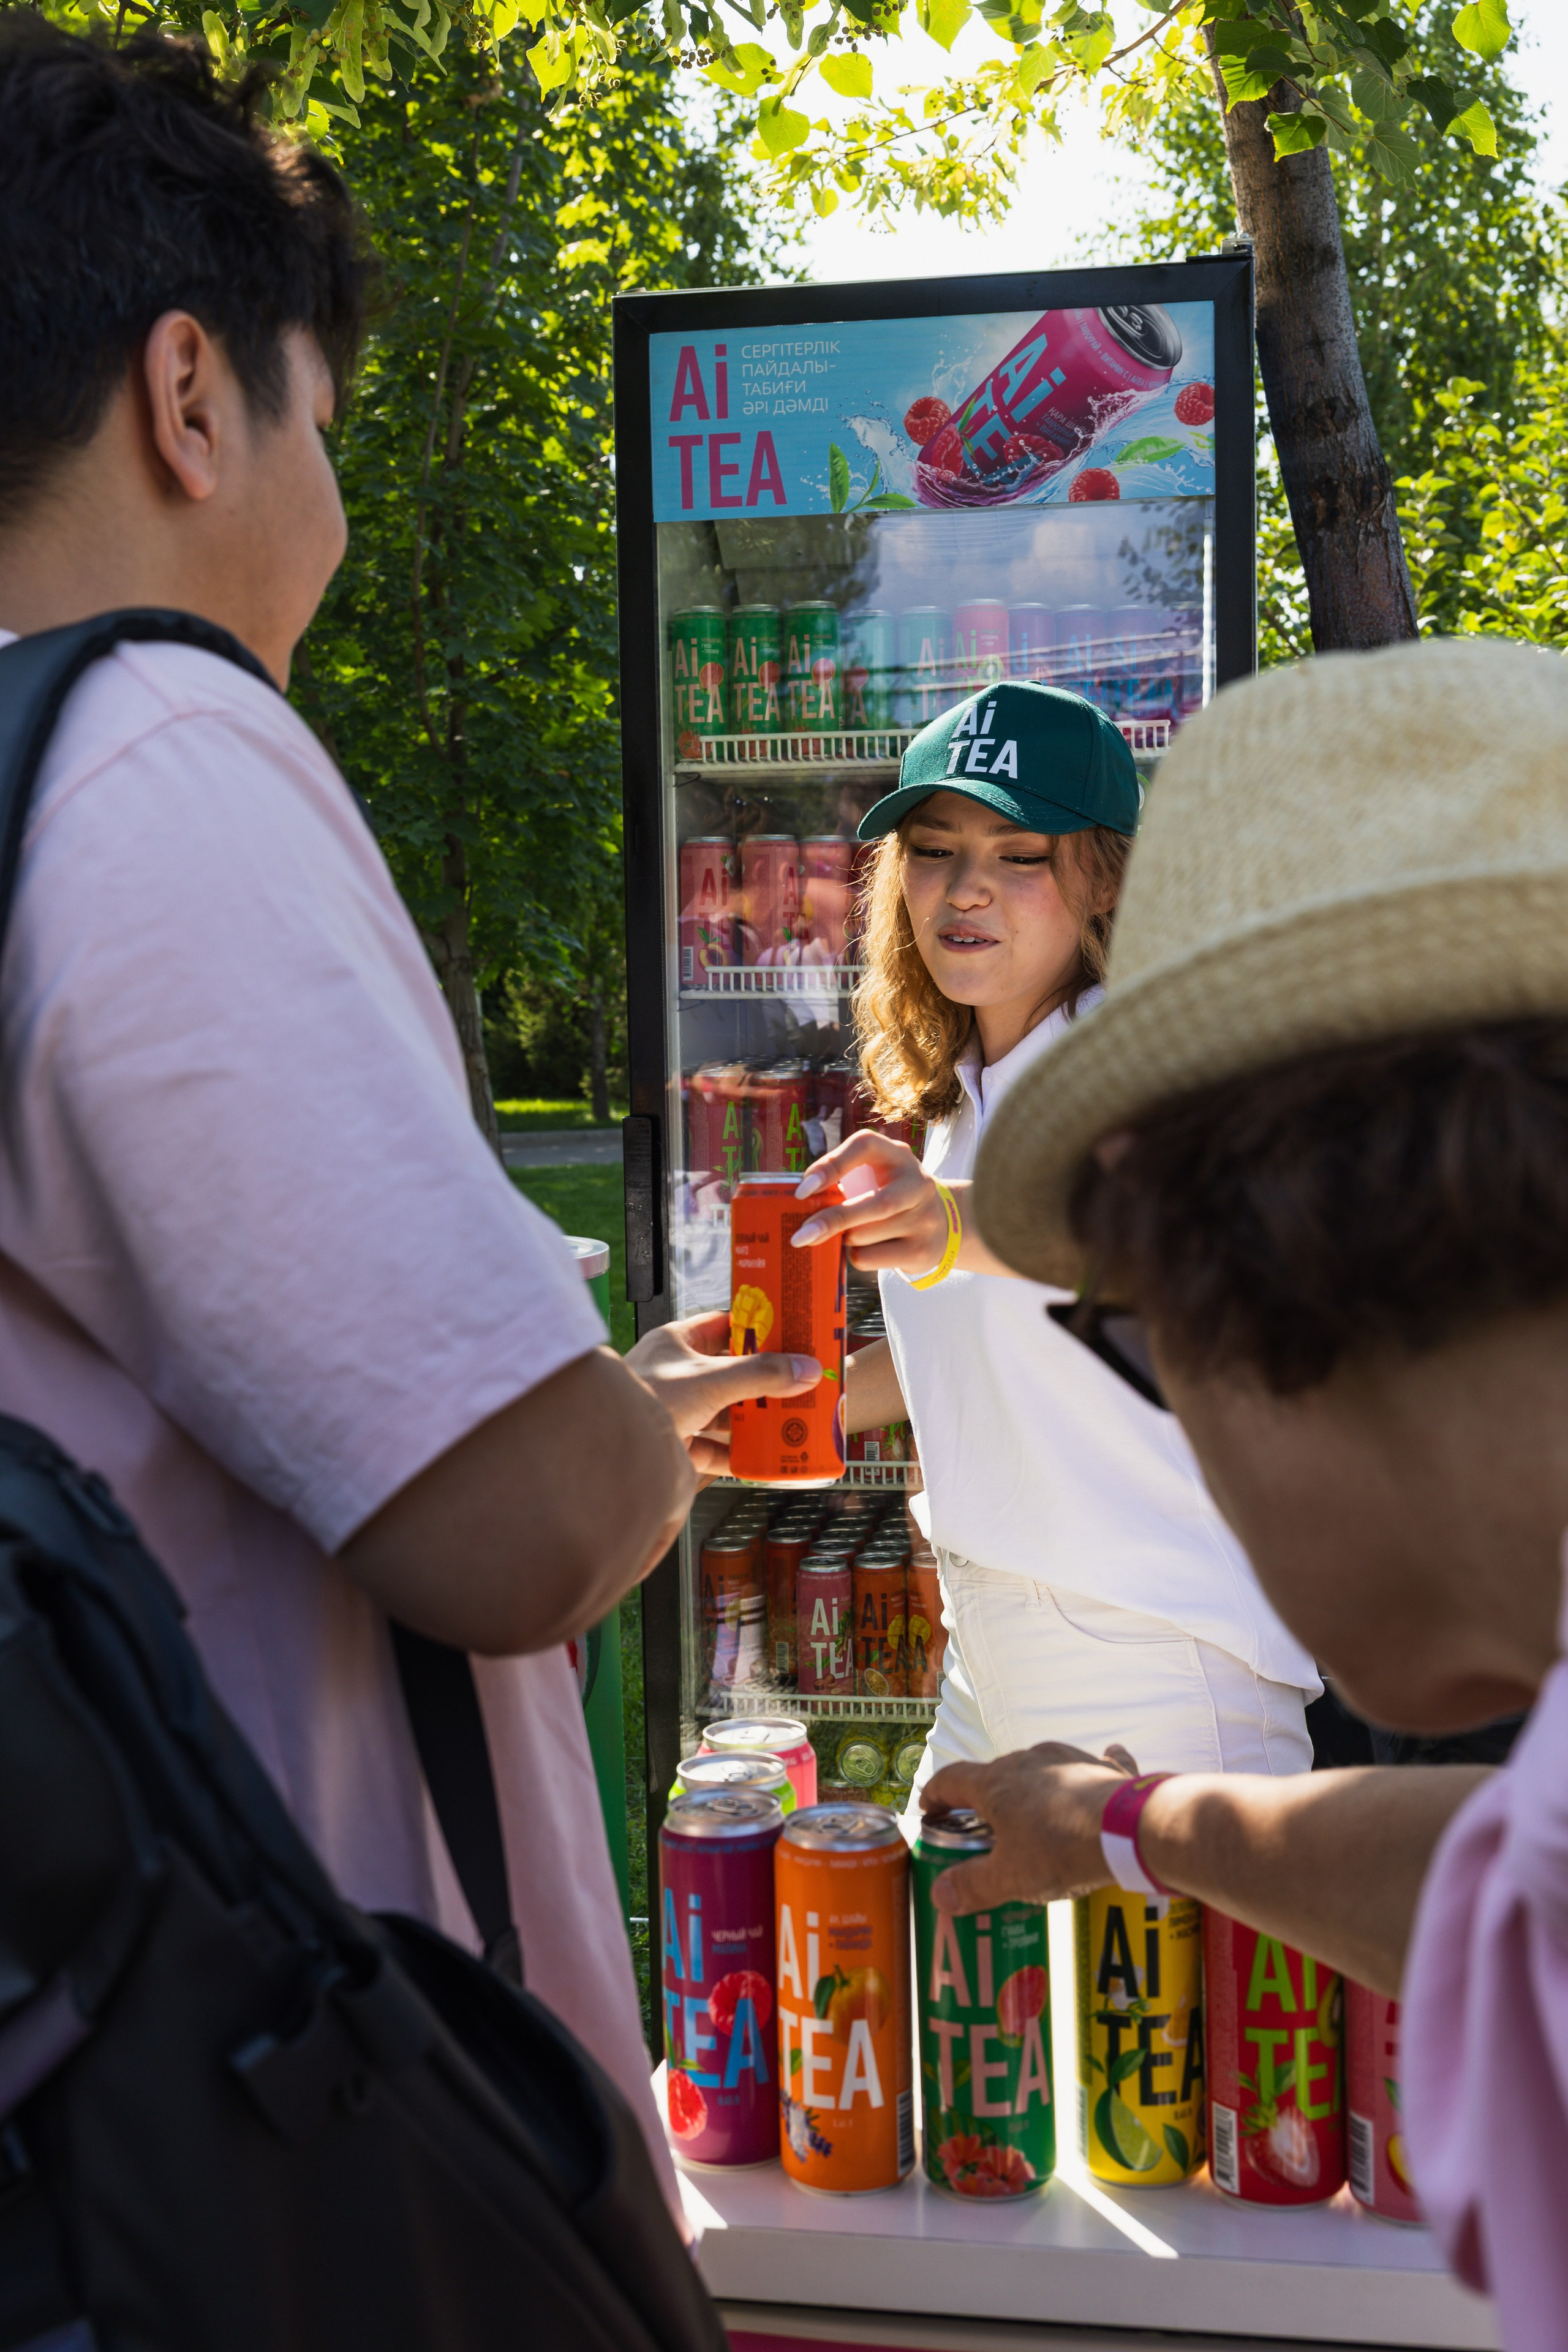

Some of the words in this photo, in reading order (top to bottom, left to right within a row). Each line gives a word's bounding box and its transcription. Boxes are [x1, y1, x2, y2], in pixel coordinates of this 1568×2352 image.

[741, 341, 841, 359] СЕРГІТЕРЛІК
[669, 344, 729, 422] Ai
[742, 380, 807, 396] ТАБИҒИ
[742, 401, 769, 415] ӘРІ
[772, 398, 829, 416] ДӘМДІ
[668, 431, 788, 510] TEA
[675, 638, 698, 679] Ai
[733, 636, 757, 676] Ai
[788, 634, 810, 674] Ai
[954, 630, 978, 669] Ai
[675, 683, 724, 723] TEA
[733, 682, 781, 722] TEA
[788, 679, 835, 720] TEA
[951, 701, 997, 738] Ai
[946, 739, 1018, 779] TEA
[699, 868, 728, 906] Ai
[810, 1597, 839, 1635] Ai
[861, 1593, 888, 1630] Ai
[810, 1638, 854, 1679] TEA
[861, 1634, 911, 1675] TEA
[663, 1887, 704, 1983] Ai
[777, 1903, 821, 2002] Ai
[1097, 1905, 1161, 1999] Ai
[929, 1911, 994, 2008] Ai
[663, 1991, 770, 2088] TEA
[778, 2005, 884, 2110] TEA
[1098, 2006, 1205, 2107] TEA
[929, 2015, 1051, 2119] TEA
[1245, 2027, 1344, 2121] TE
